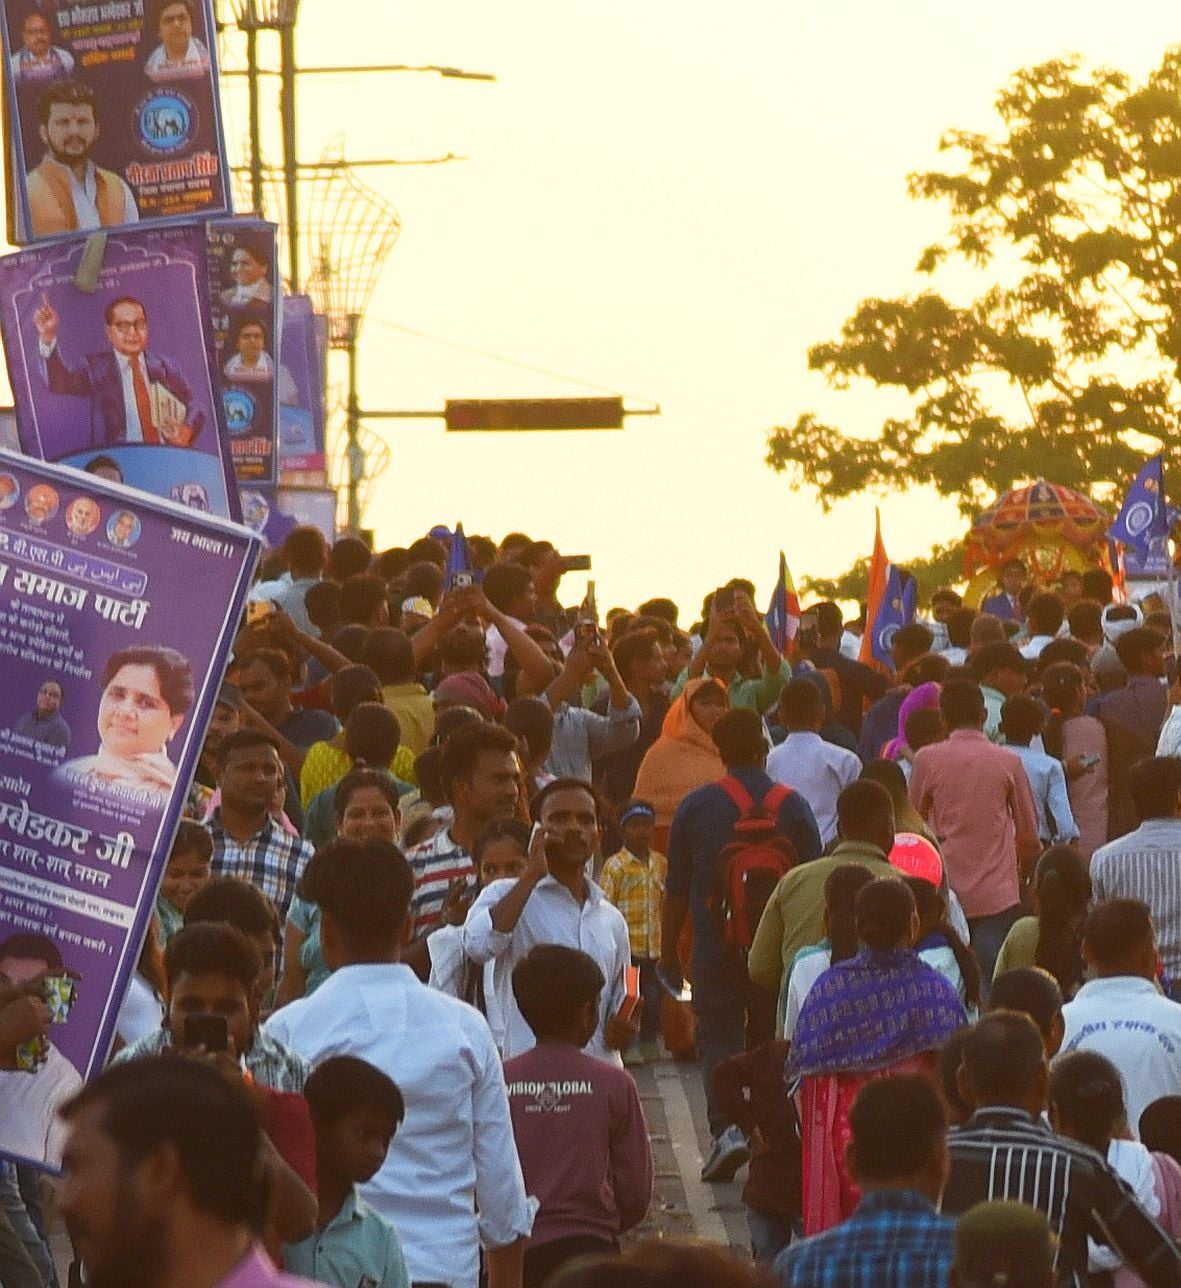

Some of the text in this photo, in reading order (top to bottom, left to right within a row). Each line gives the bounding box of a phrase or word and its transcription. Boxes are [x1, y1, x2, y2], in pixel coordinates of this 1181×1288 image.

[14, 568, 88, 610] समाज
[94, 592, 151, 630] पार्टी
[96, 831, 135, 869] जी
[75, 863, 111, 889] नमन
